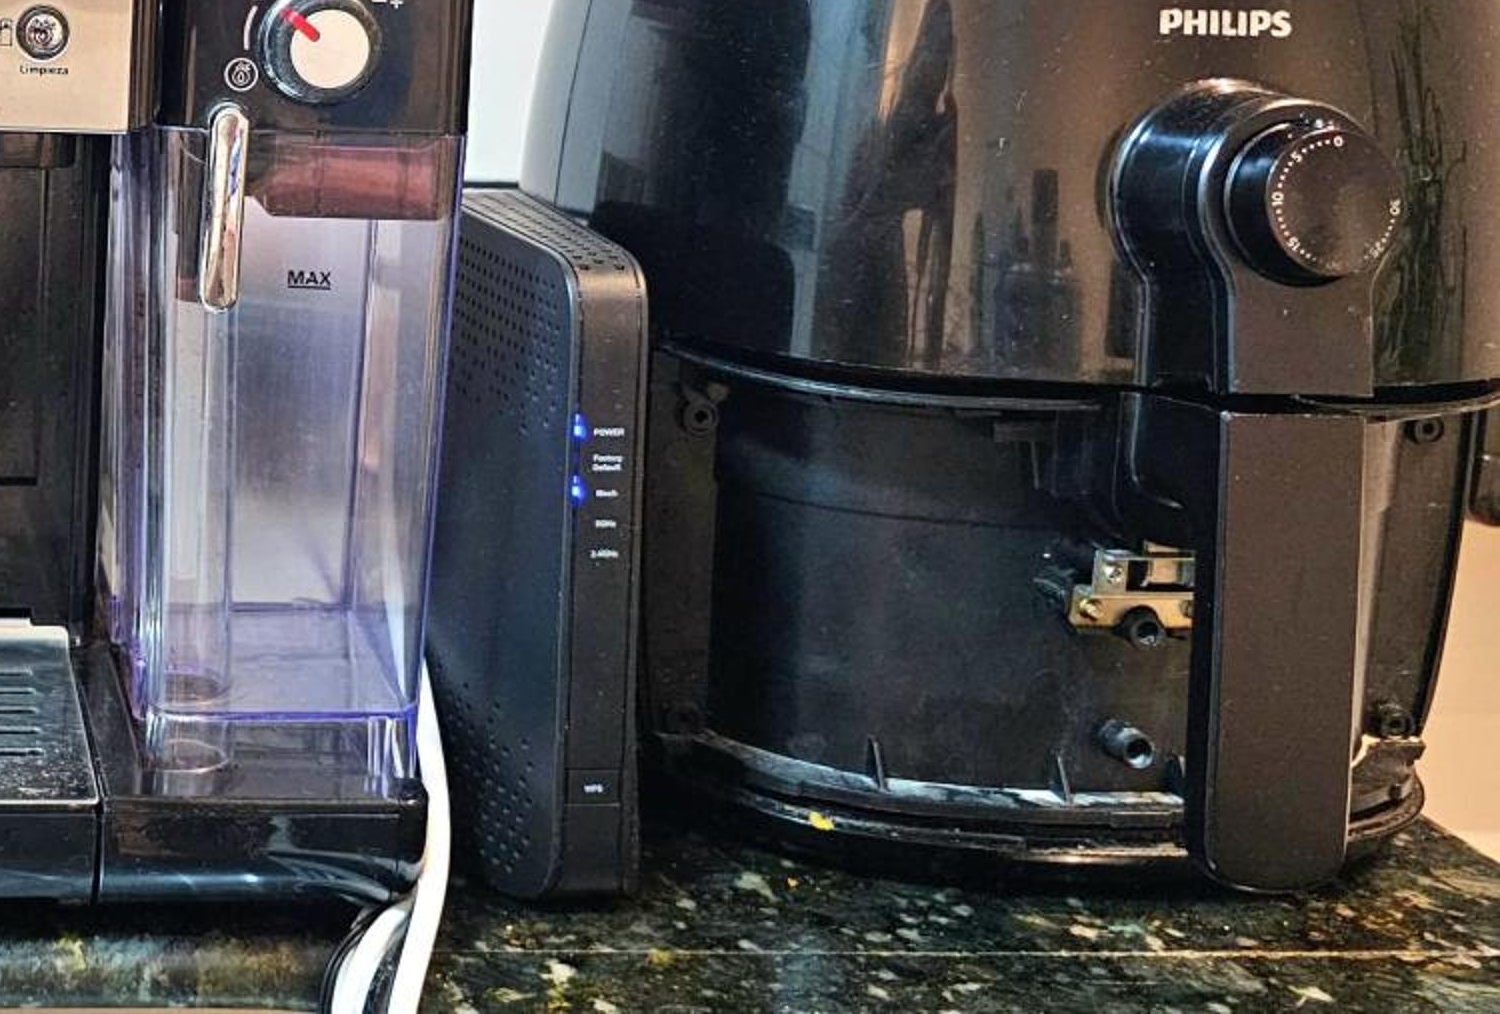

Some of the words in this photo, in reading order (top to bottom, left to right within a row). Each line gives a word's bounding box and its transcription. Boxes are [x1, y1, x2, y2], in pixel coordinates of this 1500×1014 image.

[1159, 7, 1293, 38] PHILIPS
[19, 65, 69, 76] Limpieza
[1290, 151, 1303, 163] 5
[1271, 191, 1284, 207] 10
[1286, 236, 1301, 251] 15
[287, 269, 331, 286] MAX
